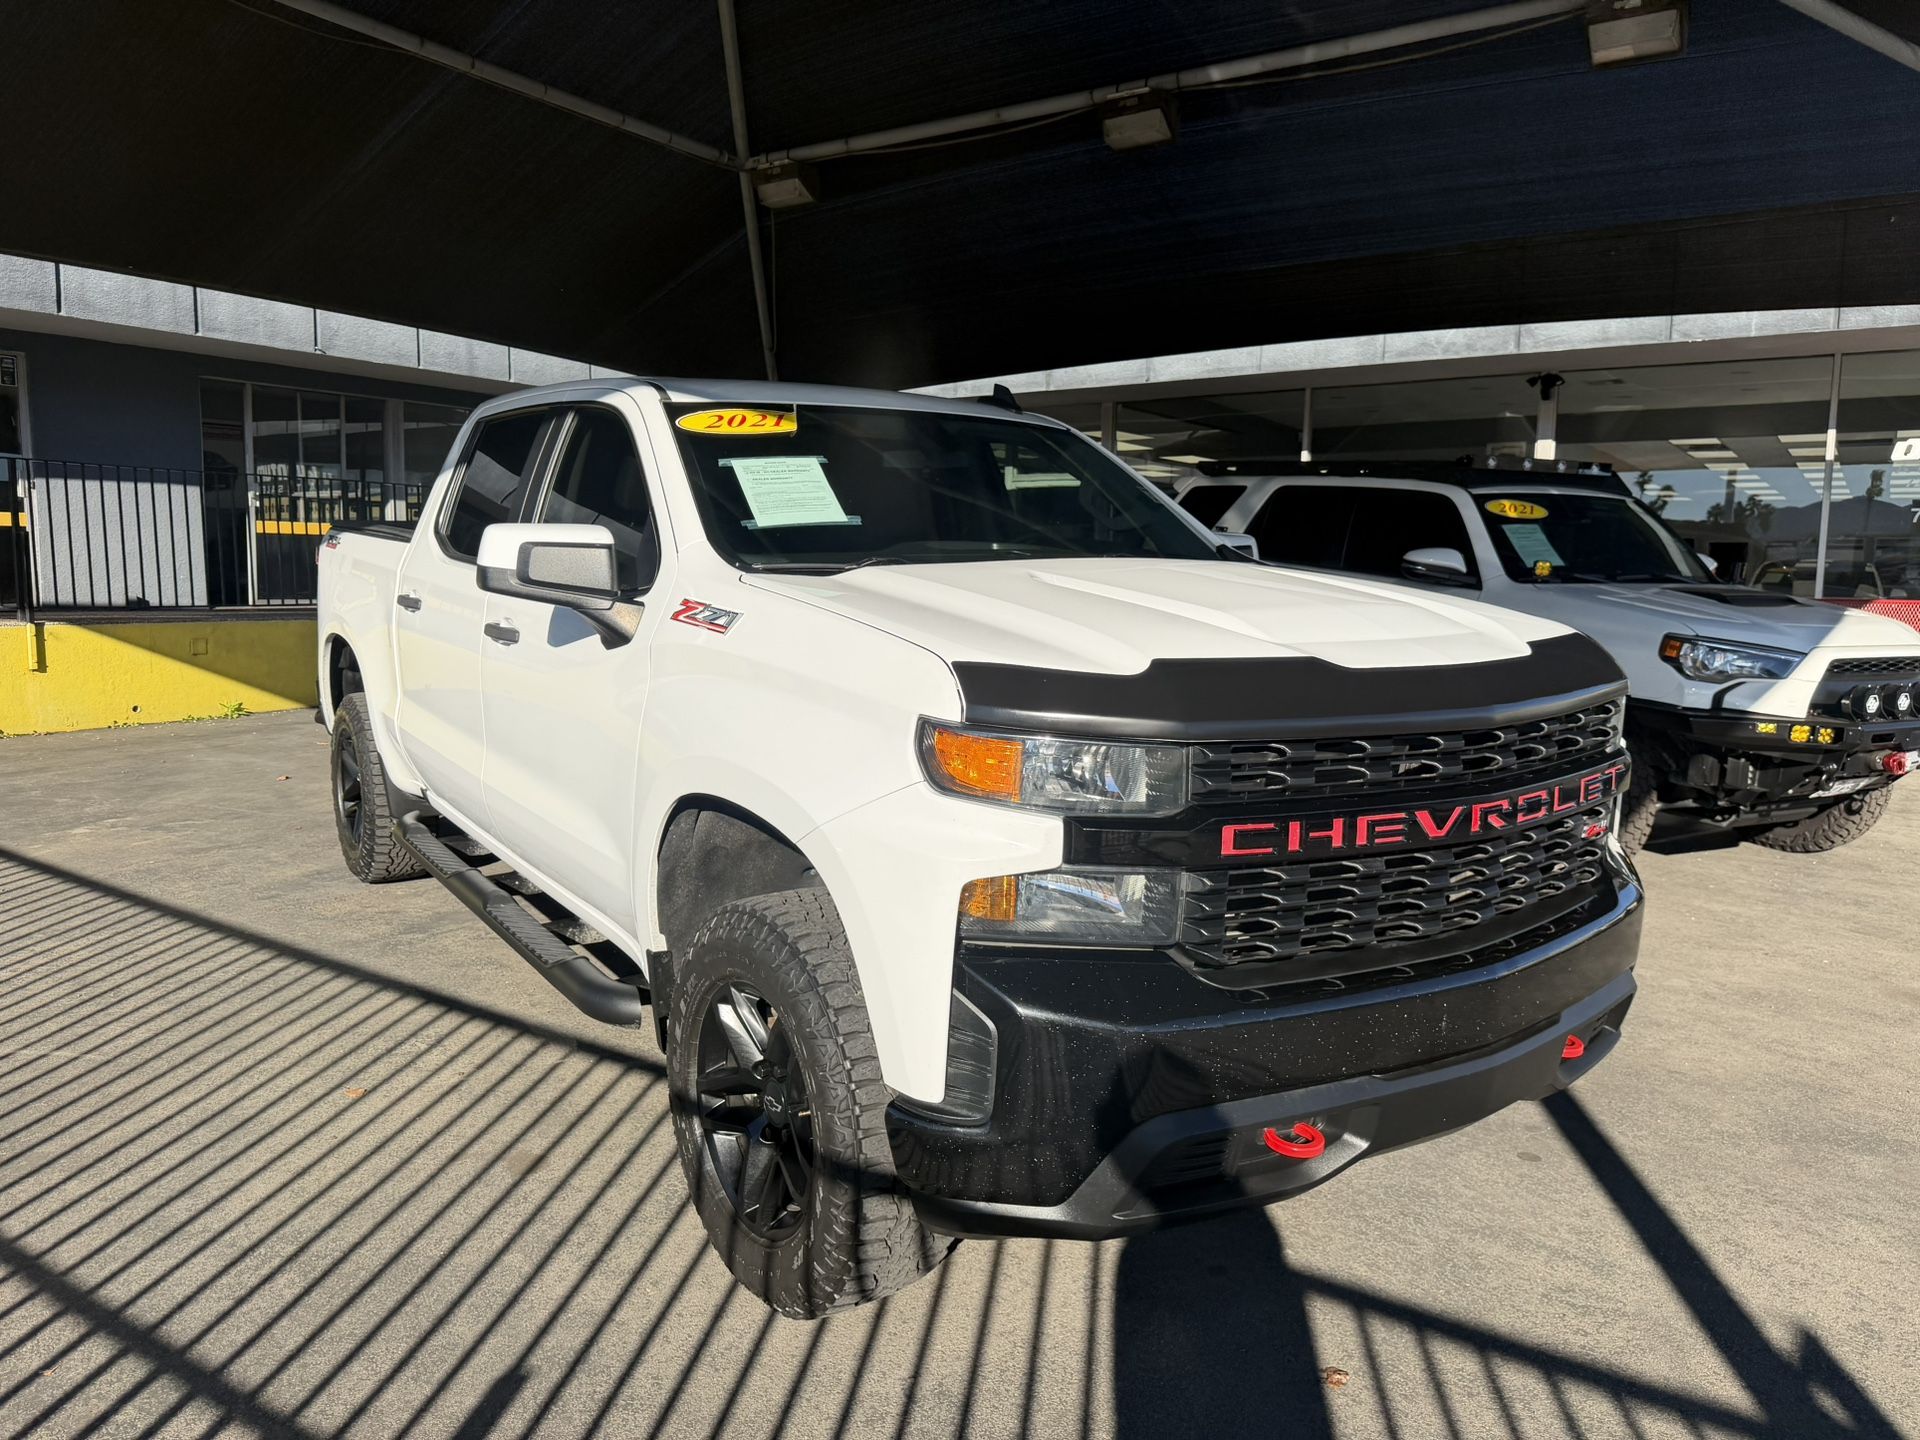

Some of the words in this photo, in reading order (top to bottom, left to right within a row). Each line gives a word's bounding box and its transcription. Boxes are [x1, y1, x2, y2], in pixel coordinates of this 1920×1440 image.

[704, 413, 786, 429] 2021
[1499, 502, 1535, 515] 2021
[670, 598, 744, 634] Z71
[1219, 763, 1626, 858] CHEVROLET
